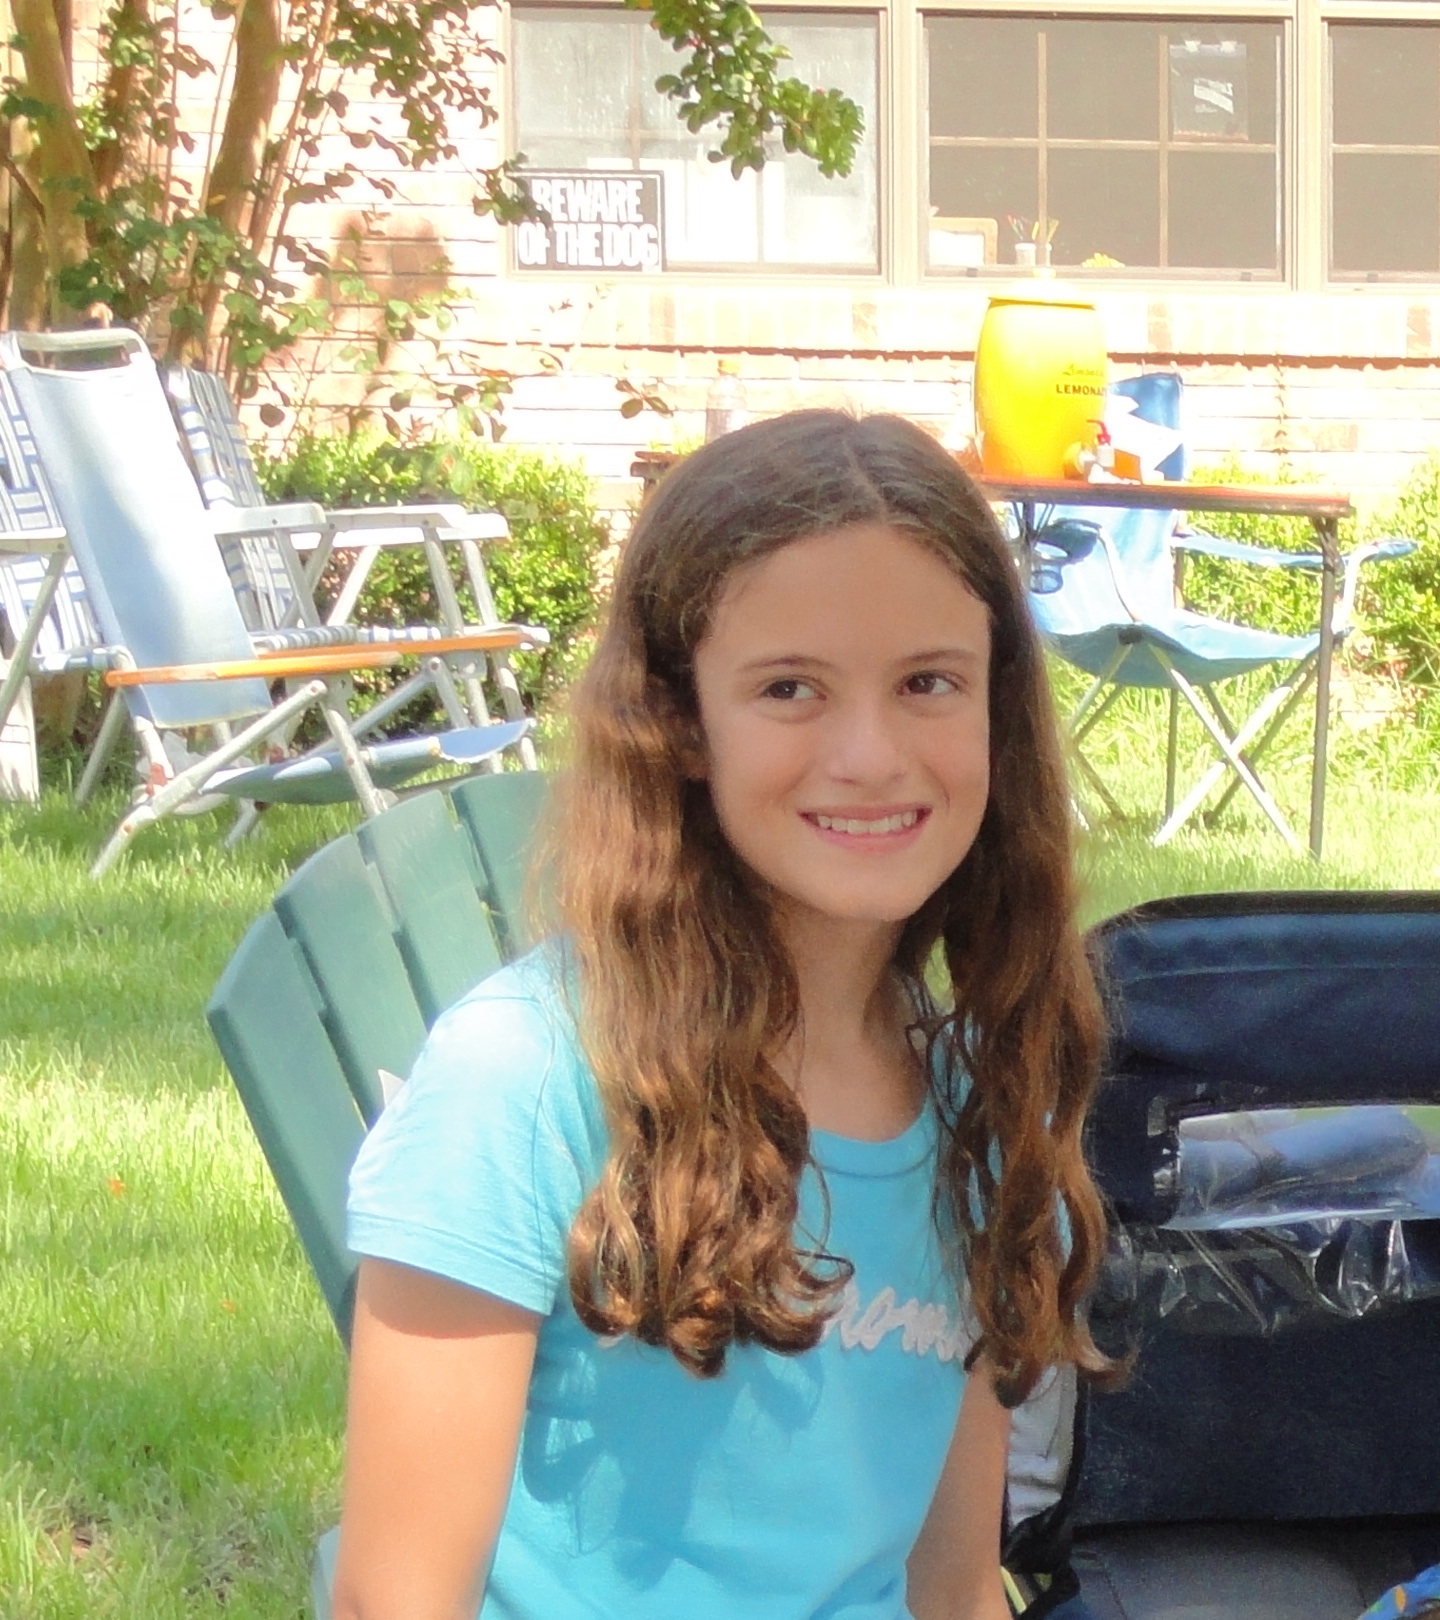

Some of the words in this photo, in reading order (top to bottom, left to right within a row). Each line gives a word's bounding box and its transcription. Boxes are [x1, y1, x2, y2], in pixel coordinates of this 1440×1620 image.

[531, 179, 644, 223] BEWARE
[518, 221, 551, 266] OF
[553, 222, 603, 266] THE
[602, 223, 659, 267] DOG
